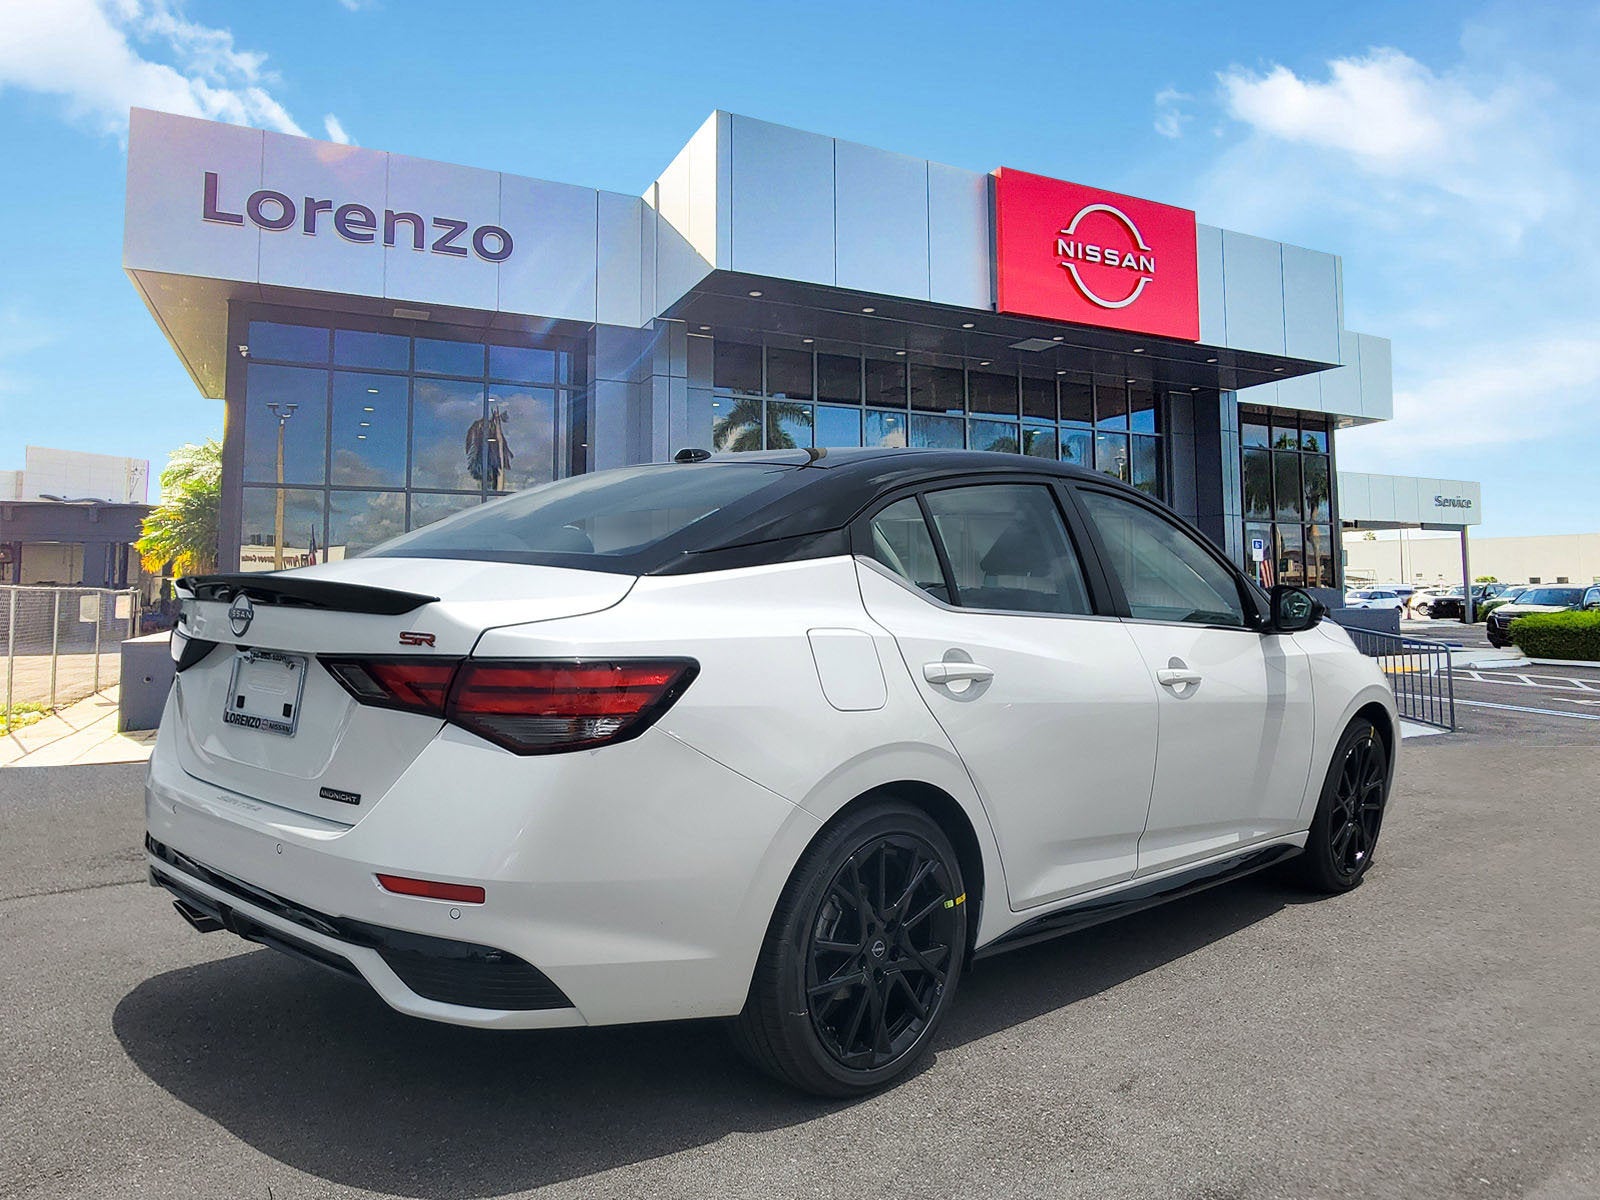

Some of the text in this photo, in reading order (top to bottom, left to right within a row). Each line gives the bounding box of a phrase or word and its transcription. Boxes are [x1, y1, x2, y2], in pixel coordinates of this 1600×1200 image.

[202, 170, 514, 262] Lorenzo
[1057, 238, 1155, 273] NISSAN
[1434, 495, 1472, 508] Service
[399, 631, 436, 648] SR
[225, 711, 291, 732] LORENZO NISSAN
[320, 789, 357, 803] MIDNIGHT
